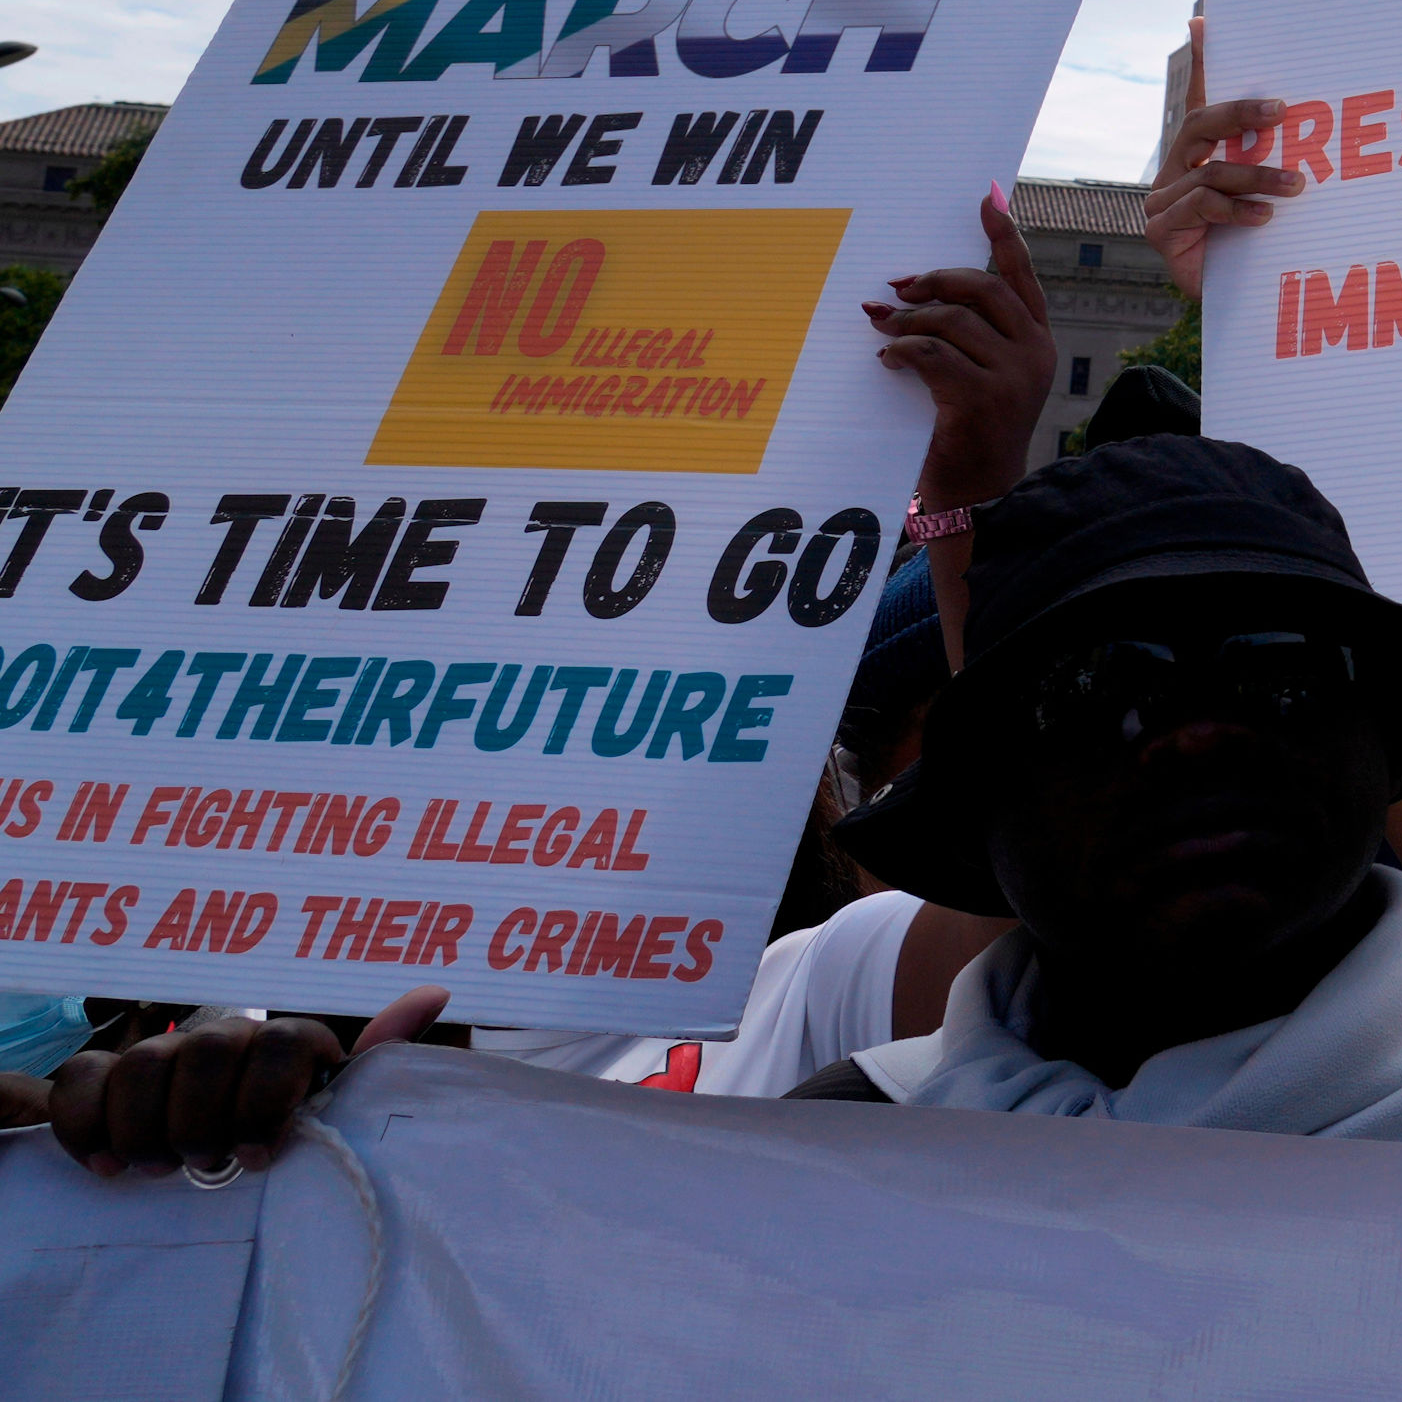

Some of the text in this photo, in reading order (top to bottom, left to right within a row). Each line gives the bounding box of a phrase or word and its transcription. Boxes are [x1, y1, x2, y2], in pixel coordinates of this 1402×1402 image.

[240, 109, 823, 190] UNTIL WE WIN
[440, 238, 606, 358] NO
[571, 327, 715, 369] ILLEGAL
[489, 374, 767, 419] IMMIGRATION
[0, 486, 881, 628] T'S TIME TO GO
[56, 781, 130, 842] IN
[130, 786, 399, 858] FIGHTING
[408, 799, 650, 872] ILLEGAL
[143, 888, 278, 953] AND
[295, 895, 474, 967] THEIR
[486, 907, 723, 985] CRIMES
